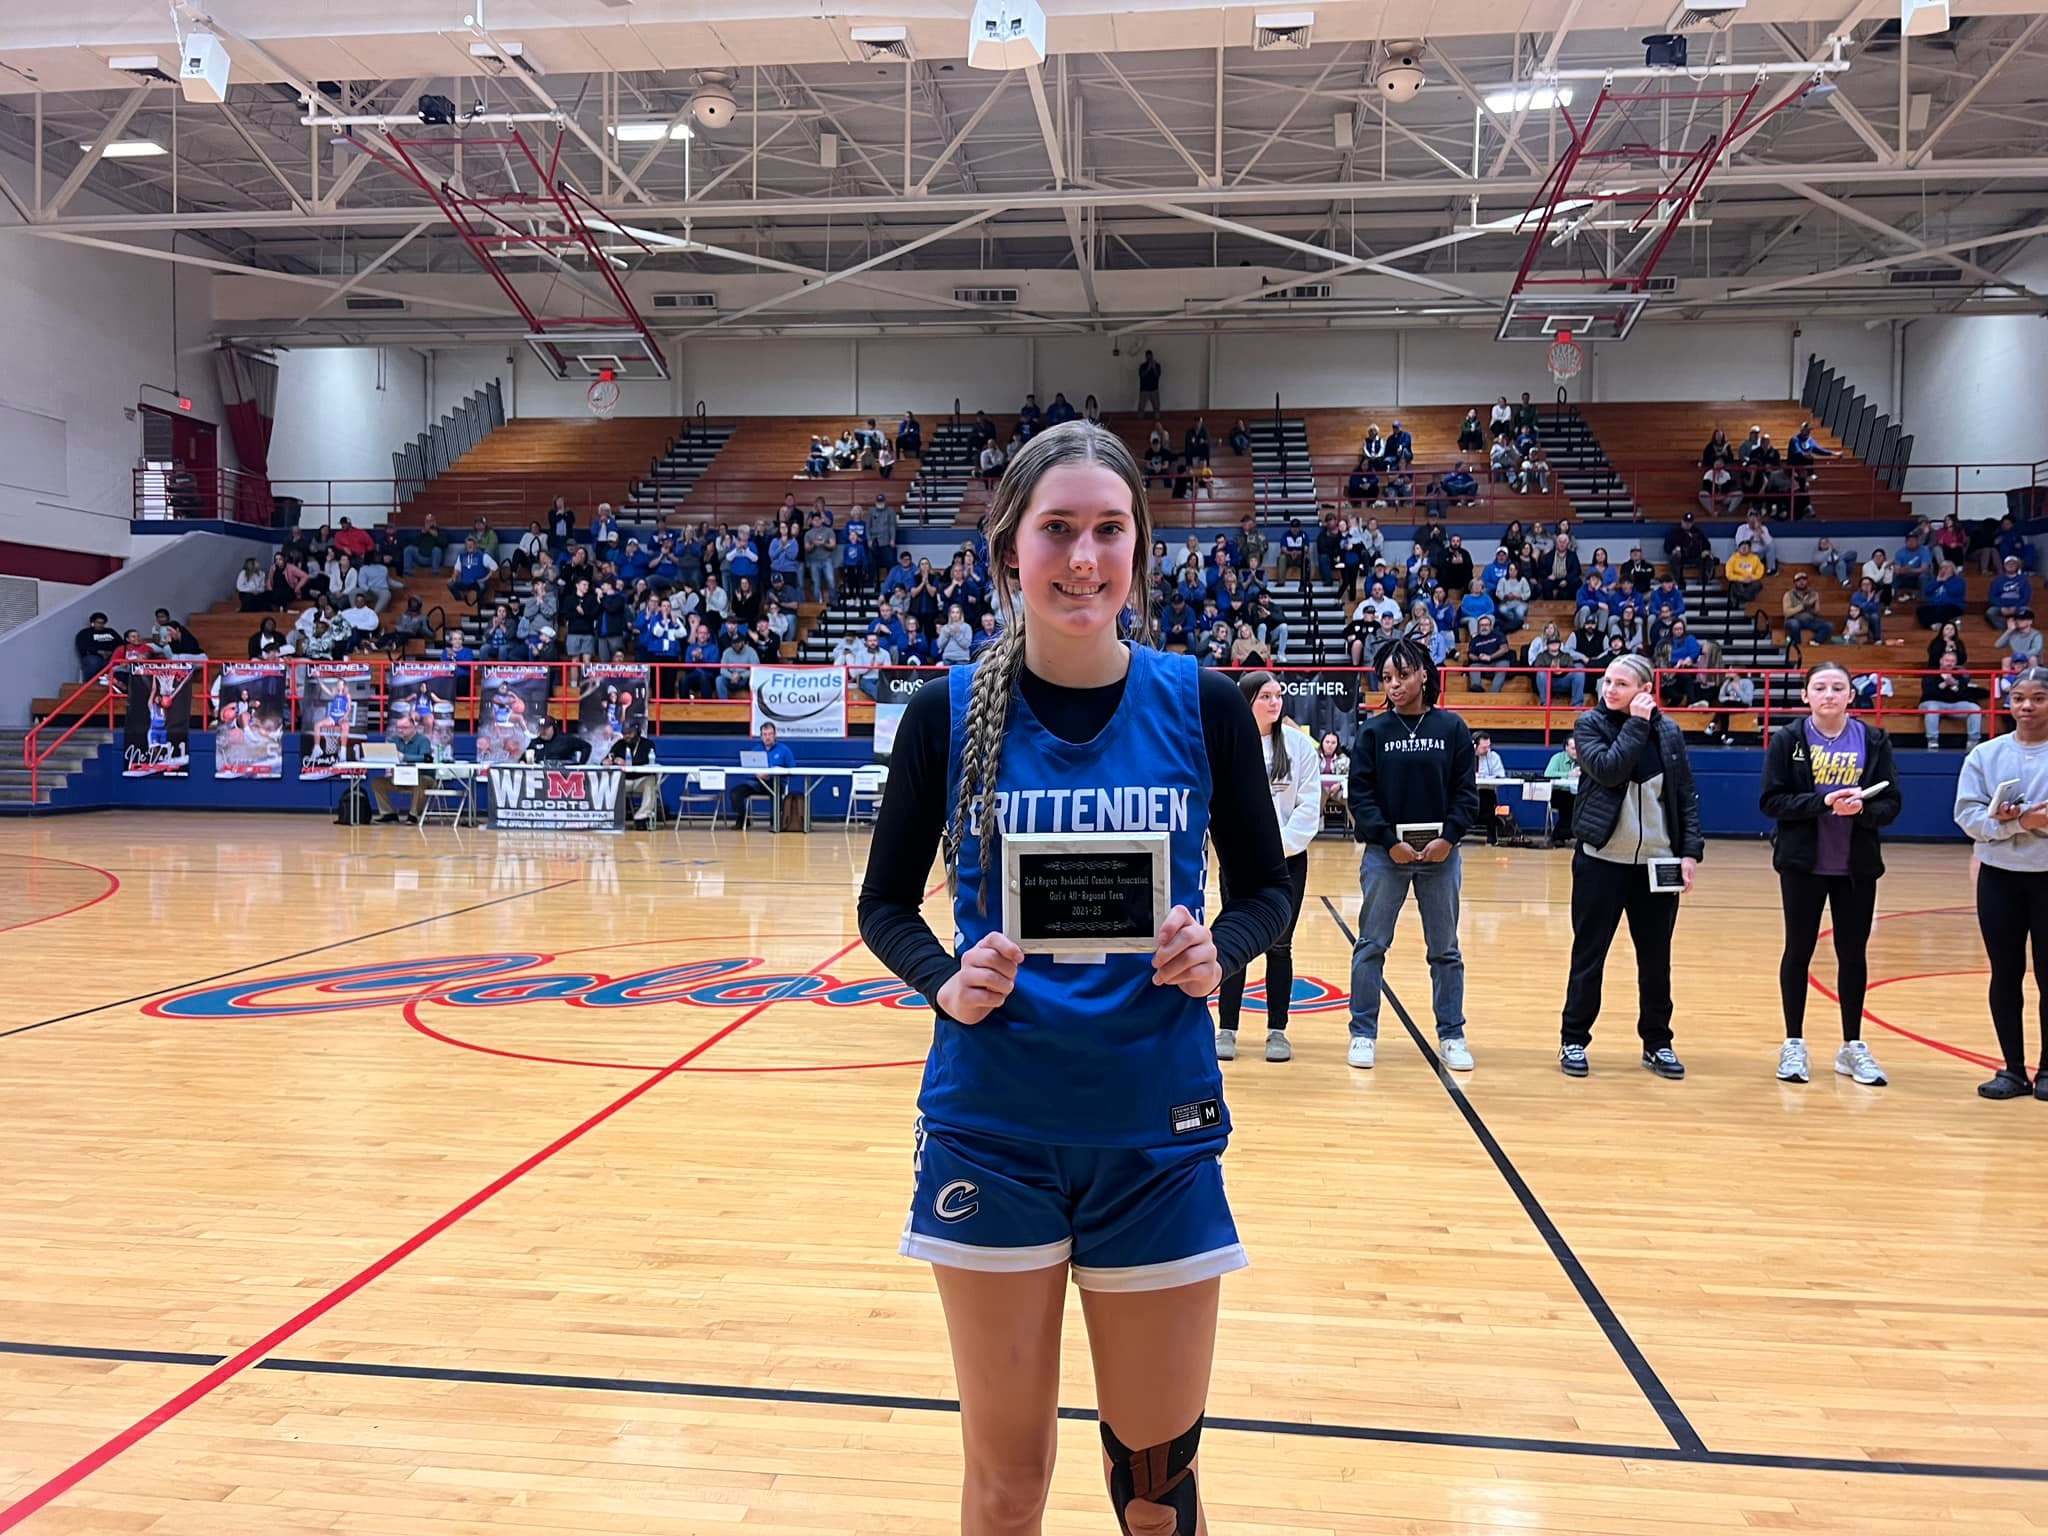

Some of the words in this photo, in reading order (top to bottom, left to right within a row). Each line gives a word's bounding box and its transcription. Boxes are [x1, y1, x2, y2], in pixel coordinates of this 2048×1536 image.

[319, 663, 369, 671] COLONELS
[771, 673, 842, 688] Friends
[1279, 682, 1348, 696] OGETHER.
[769, 692, 782, 704] of
[787, 691, 820, 704] Coal
[1384, 738, 1445, 752] SPORTSWEAR
[490, 769, 622, 810] WFMW
[522, 799, 590, 810] SPORTS
[1024, 876, 1036, 886] 2nd
[1108, 890, 1124, 900] Team
[1205, 1106, 1215, 1119] M
[933, 1179, 979, 1223] C
